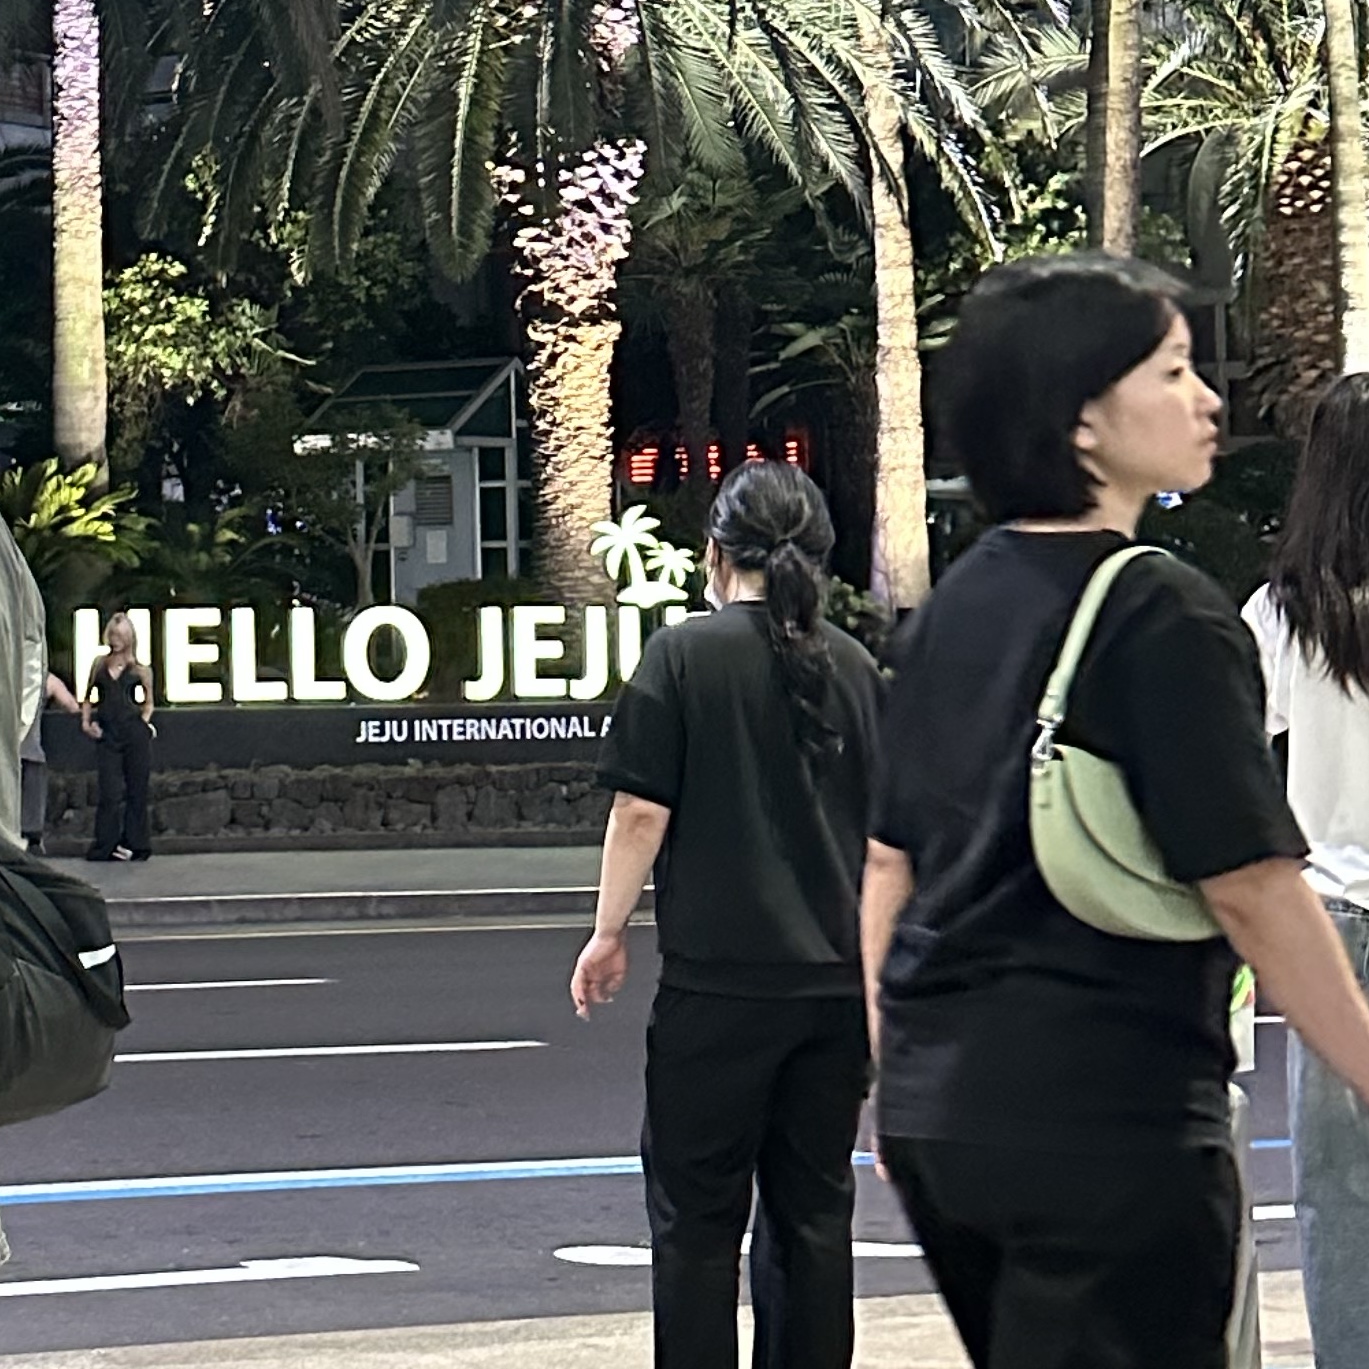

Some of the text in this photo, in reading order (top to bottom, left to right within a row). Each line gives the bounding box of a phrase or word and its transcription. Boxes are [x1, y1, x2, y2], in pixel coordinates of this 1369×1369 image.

[74, 605, 430, 702] HELLO
[355, 719, 408, 743] JEJU
[413, 715, 596, 742] INTERNATIONAL
